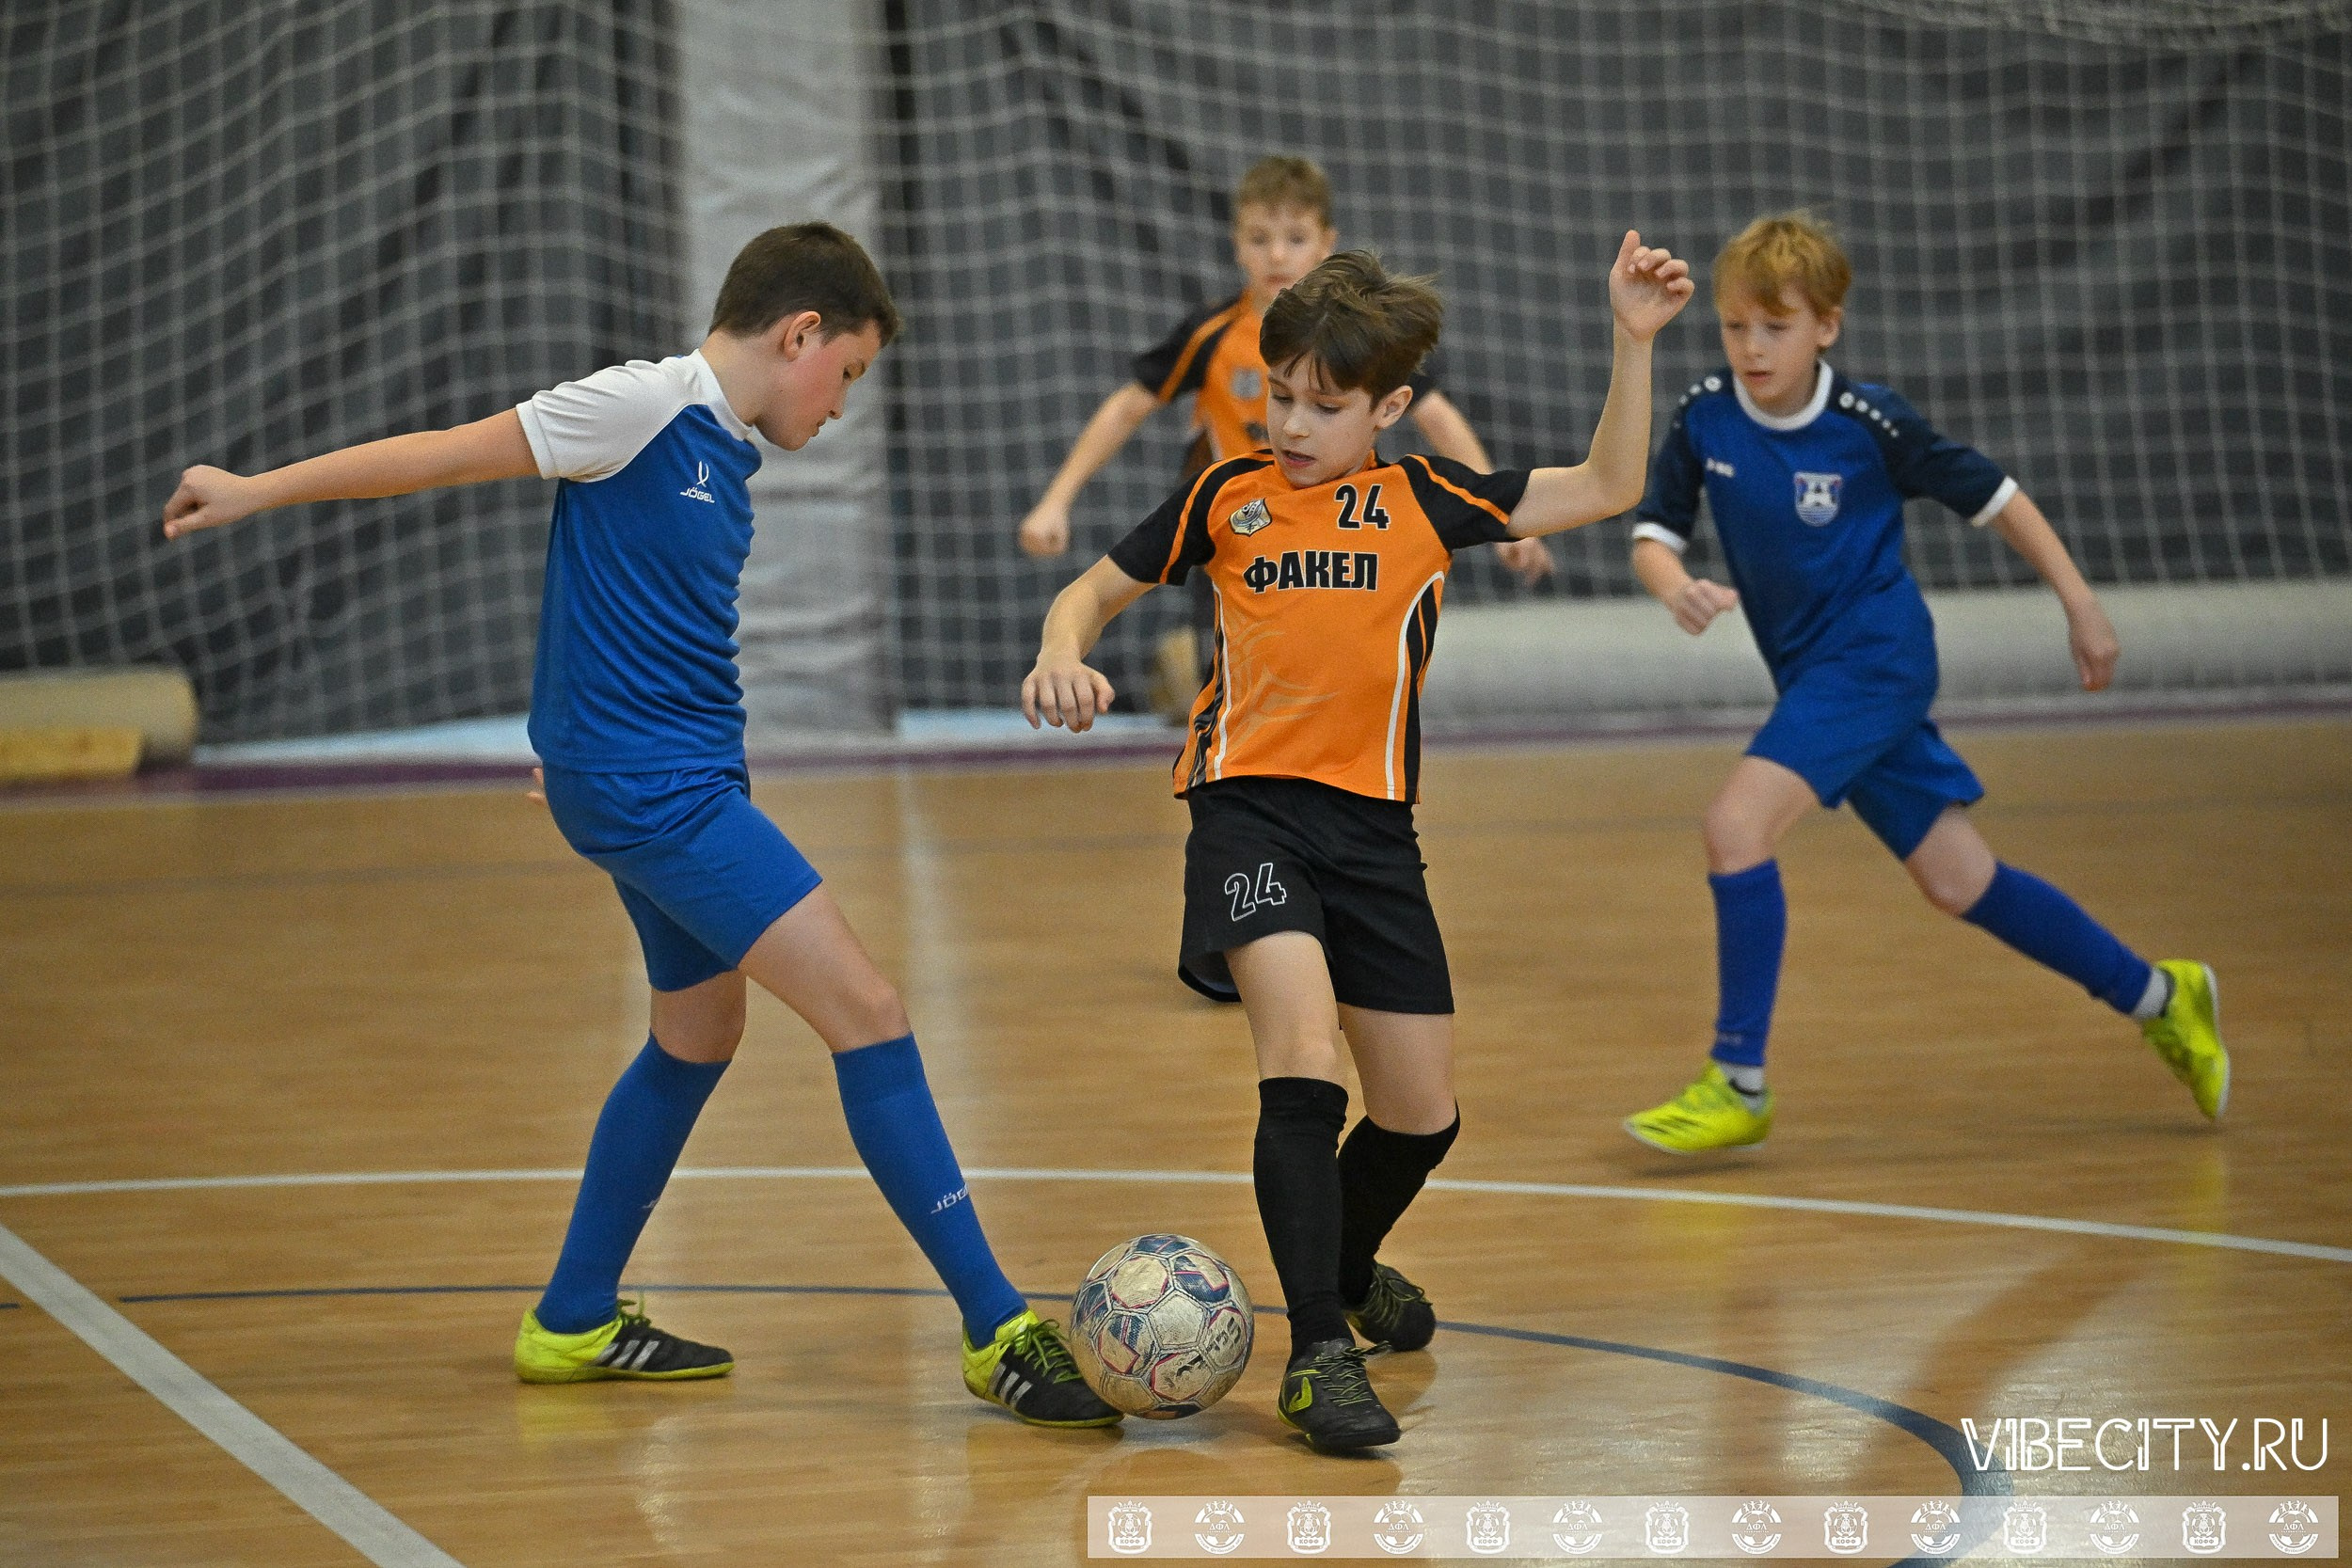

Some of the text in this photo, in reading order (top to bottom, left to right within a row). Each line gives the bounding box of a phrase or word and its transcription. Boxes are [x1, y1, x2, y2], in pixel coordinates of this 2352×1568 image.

[1334, 483, 1391, 531] 24
[1242, 550, 1379, 595] ФАКЕЛ
[1224, 863, 1288, 922] 24
[930, 1182, 969, 1214] JÖG
